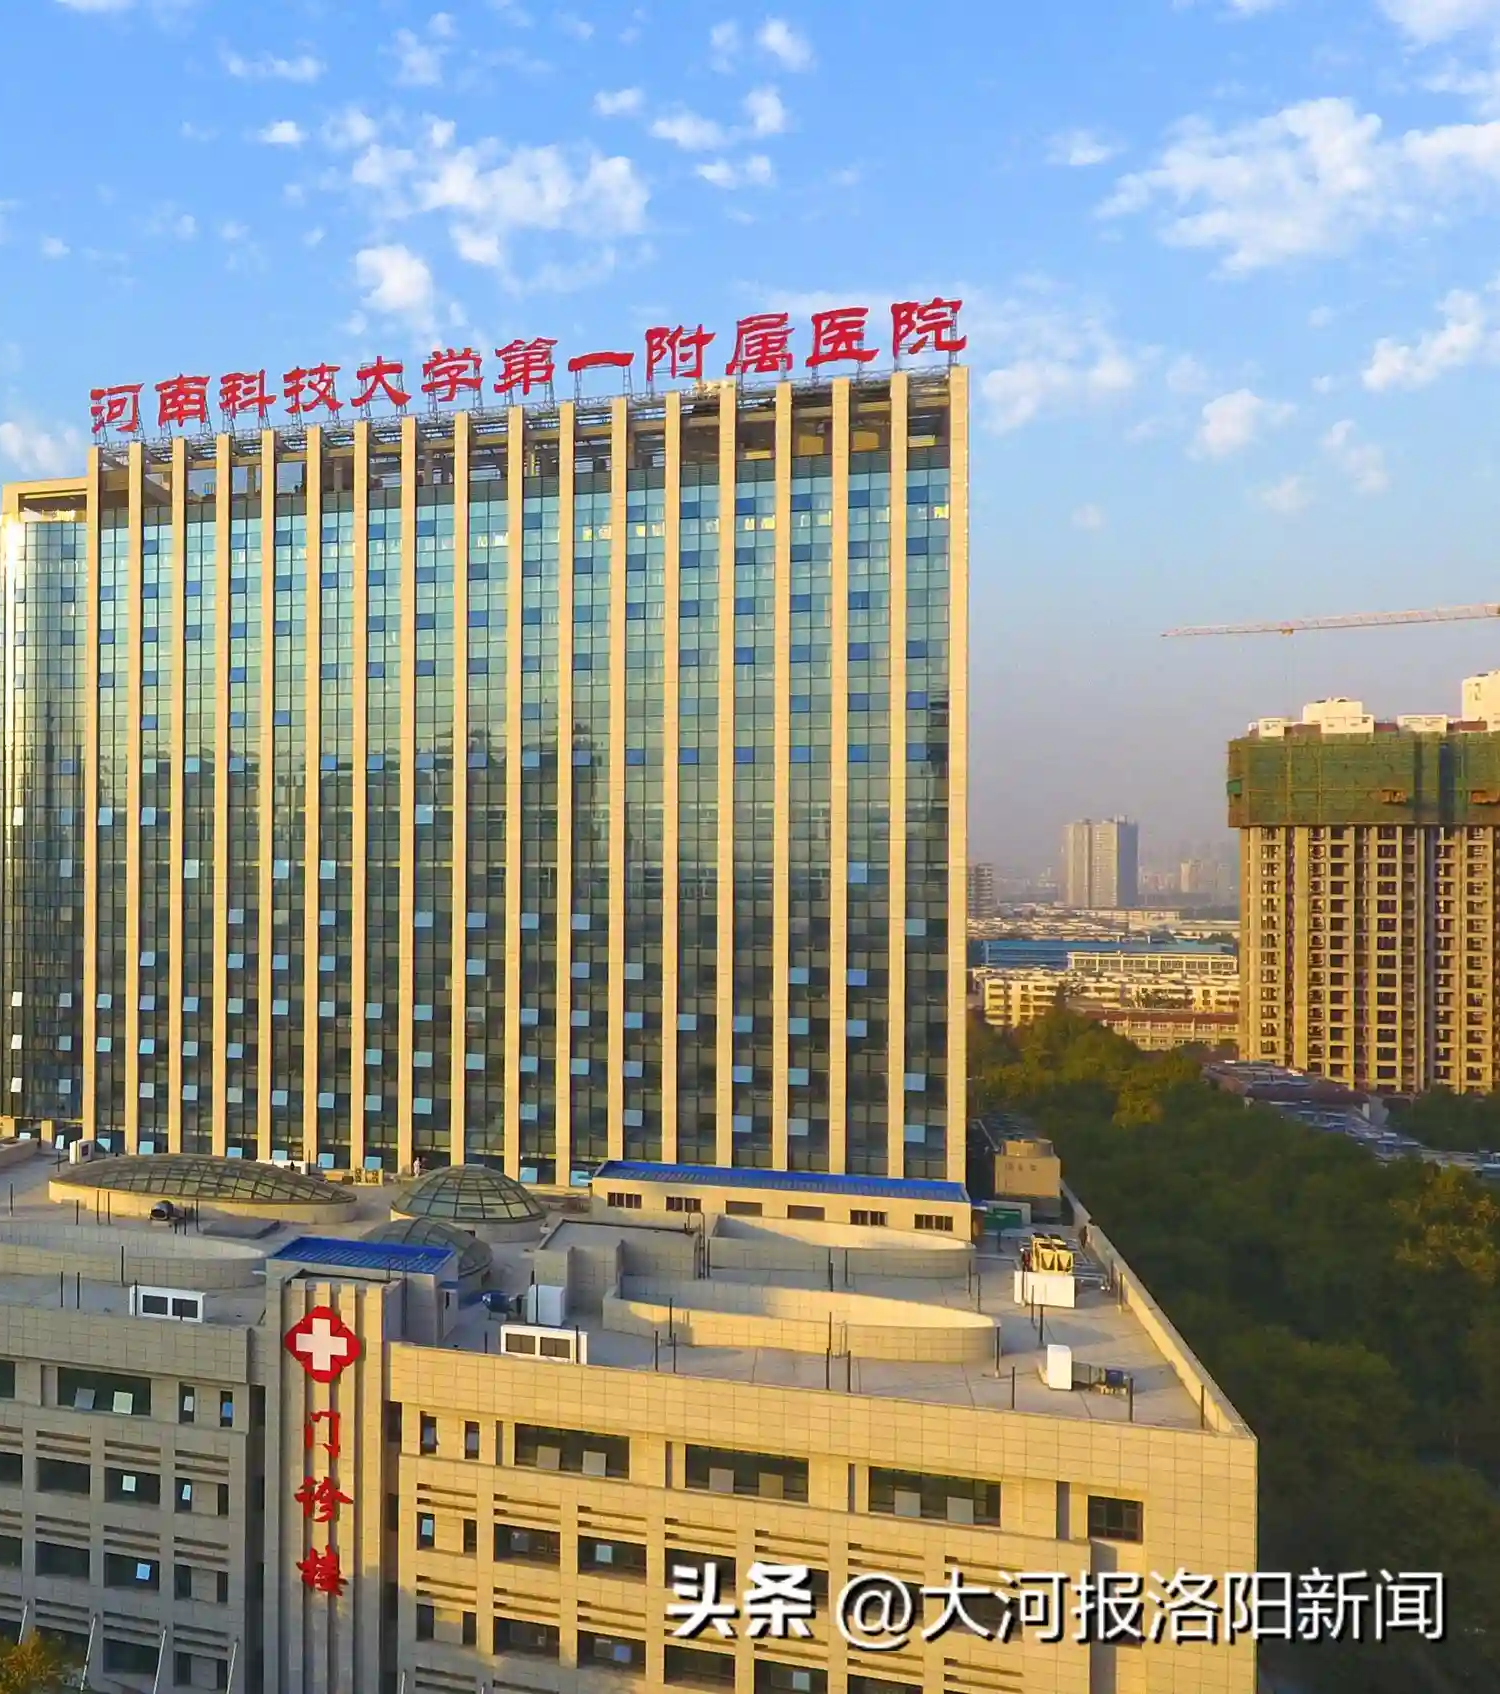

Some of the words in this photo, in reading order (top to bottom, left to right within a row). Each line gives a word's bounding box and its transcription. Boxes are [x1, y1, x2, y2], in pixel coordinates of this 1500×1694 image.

[88, 297, 968, 433] 河南科技大学第一附属医院
[294, 1410, 353, 1596] 门诊楼
